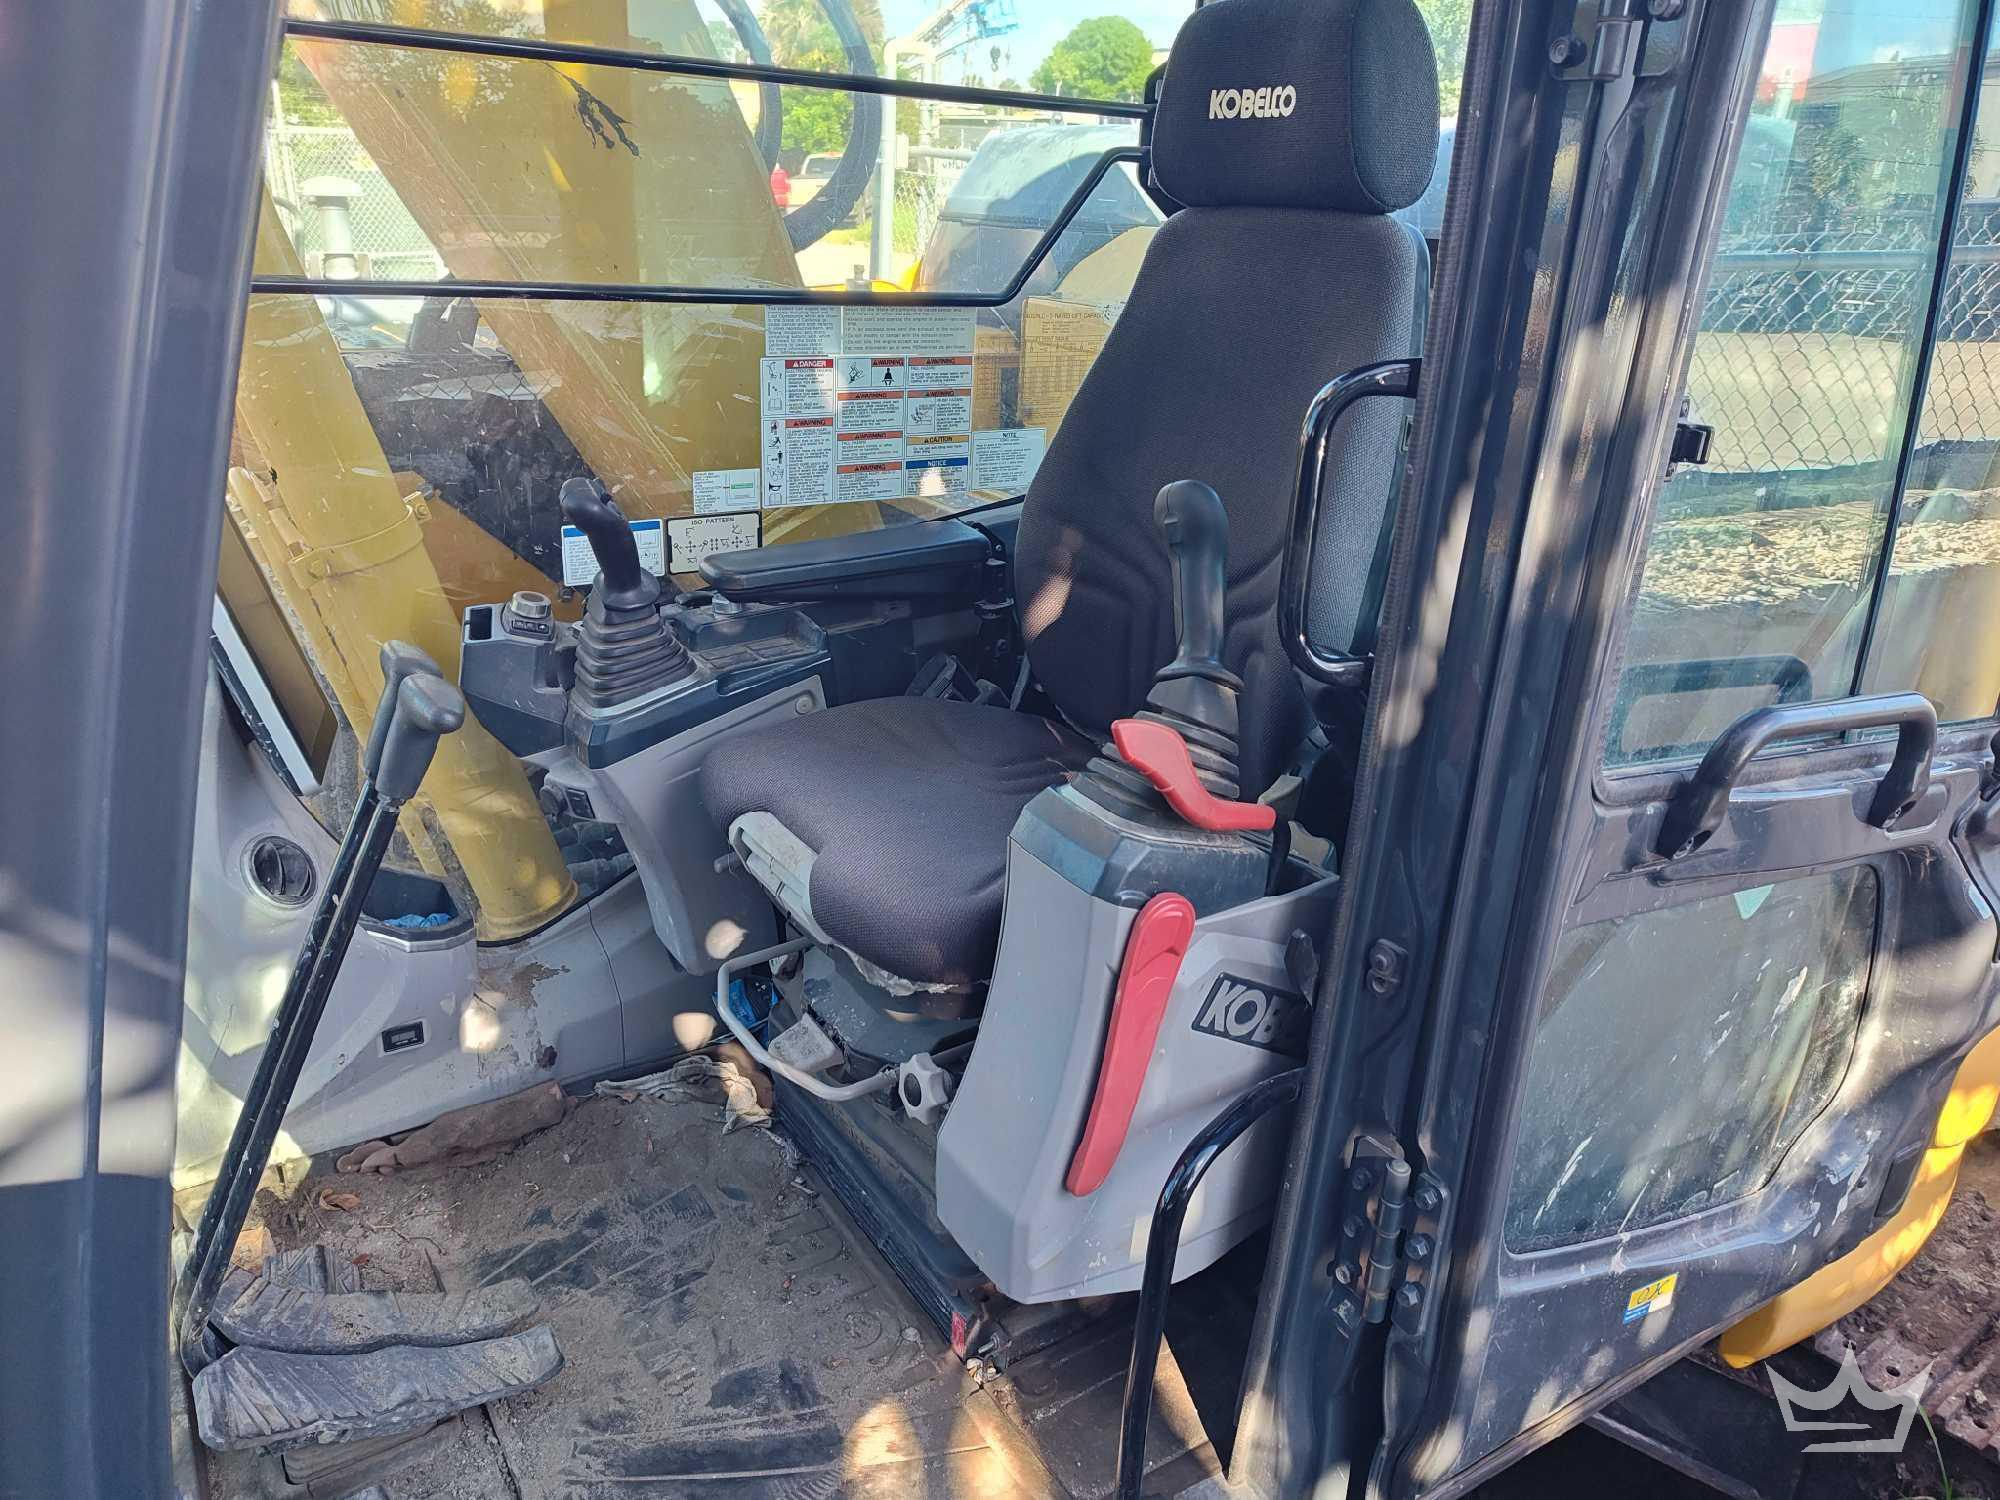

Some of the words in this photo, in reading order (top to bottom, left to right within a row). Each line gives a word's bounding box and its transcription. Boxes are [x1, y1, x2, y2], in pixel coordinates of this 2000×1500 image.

[1208, 85, 1297, 119] KOBELCO
[800, 360, 826, 368] DANGER
[859, 431, 886, 439] WARNING
[929, 436, 953, 444] CAUTION
[859, 464, 886, 472] WARNING
